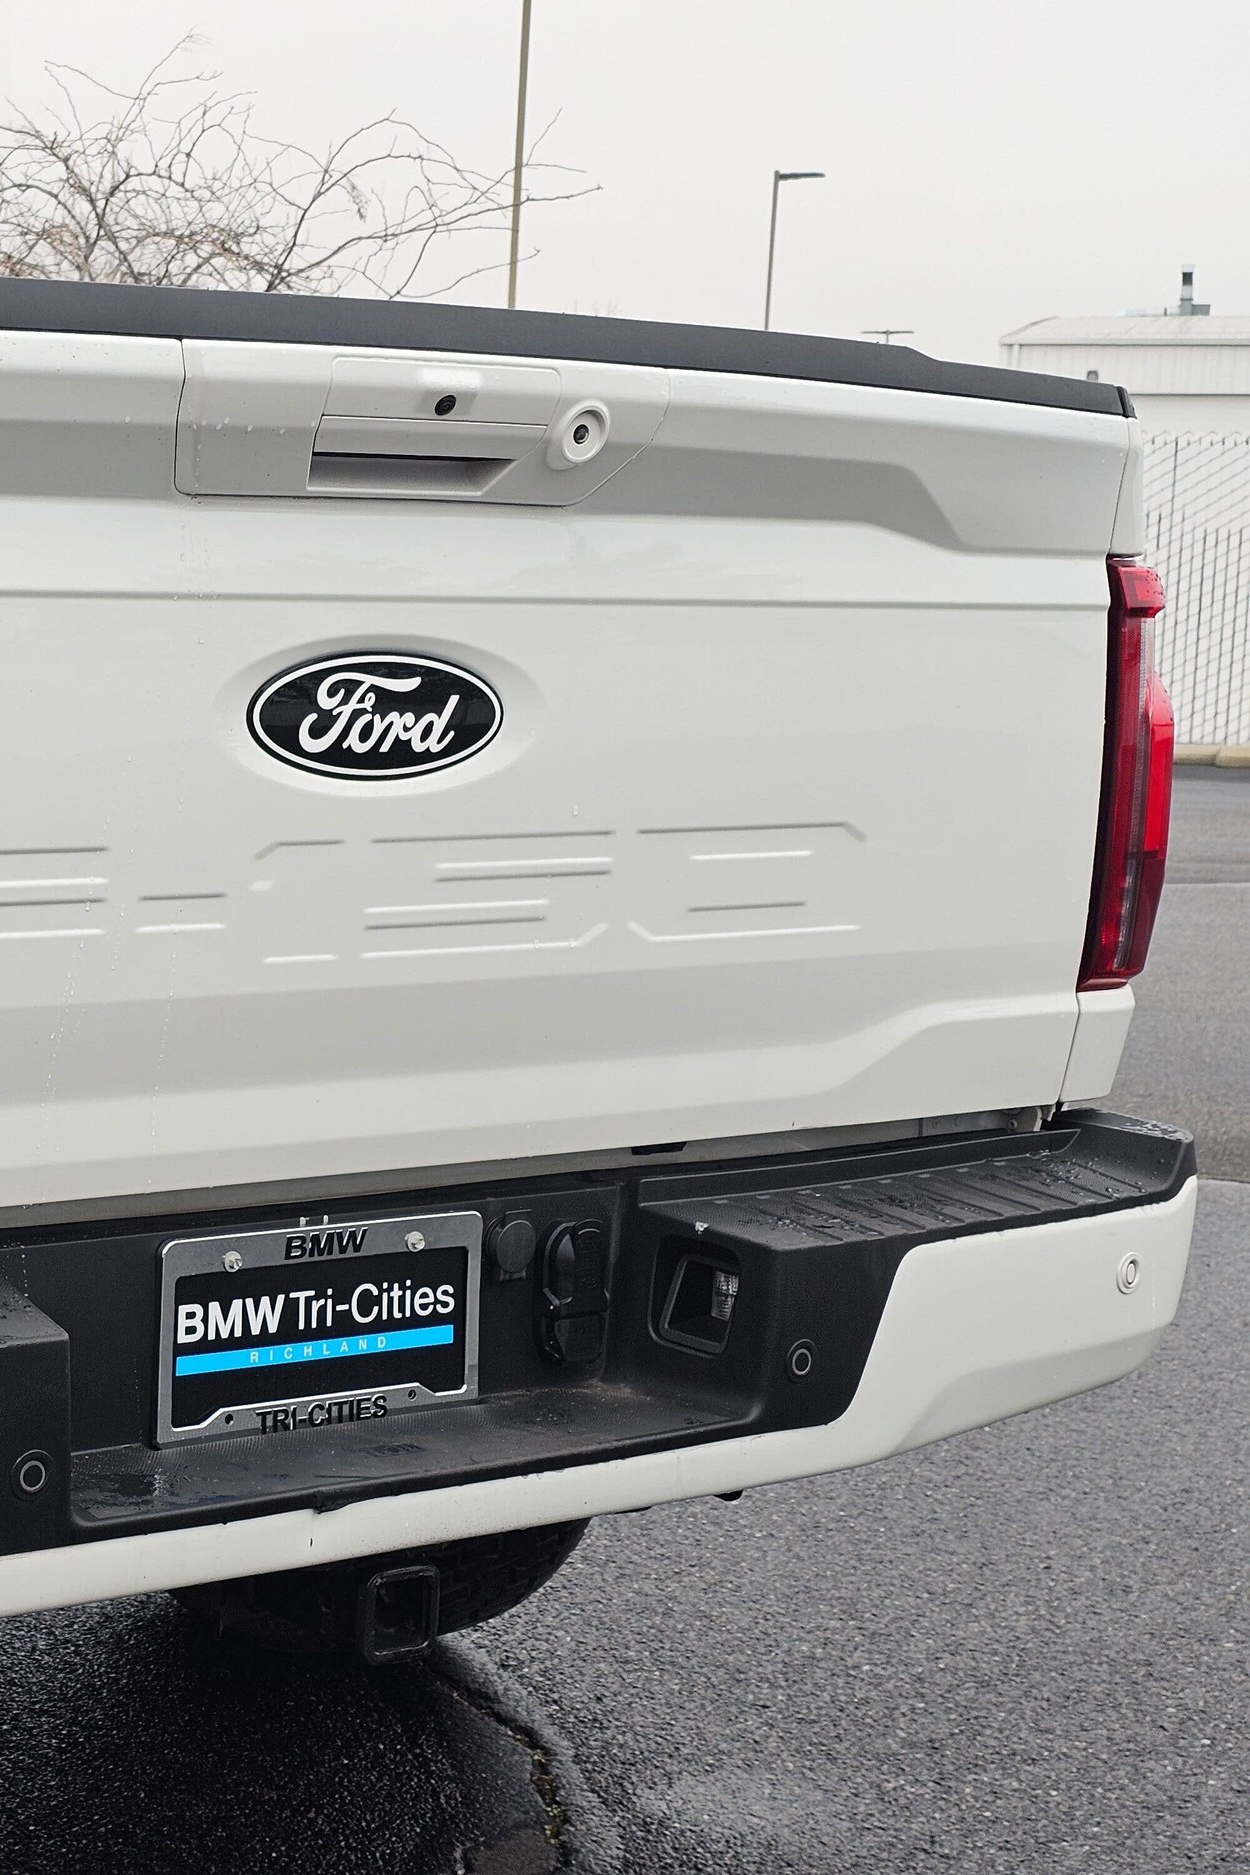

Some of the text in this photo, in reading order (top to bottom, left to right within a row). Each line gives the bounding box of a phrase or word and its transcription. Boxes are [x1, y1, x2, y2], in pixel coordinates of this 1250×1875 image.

[299, 672, 460, 753] Ford
[284, 1227, 368, 1261] BMW
[177, 1280, 455, 1344] BMW Tri-Cities
[250, 1336, 387, 1363] RICHLAND
[255, 1394, 389, 1435] TRI-CITIES
